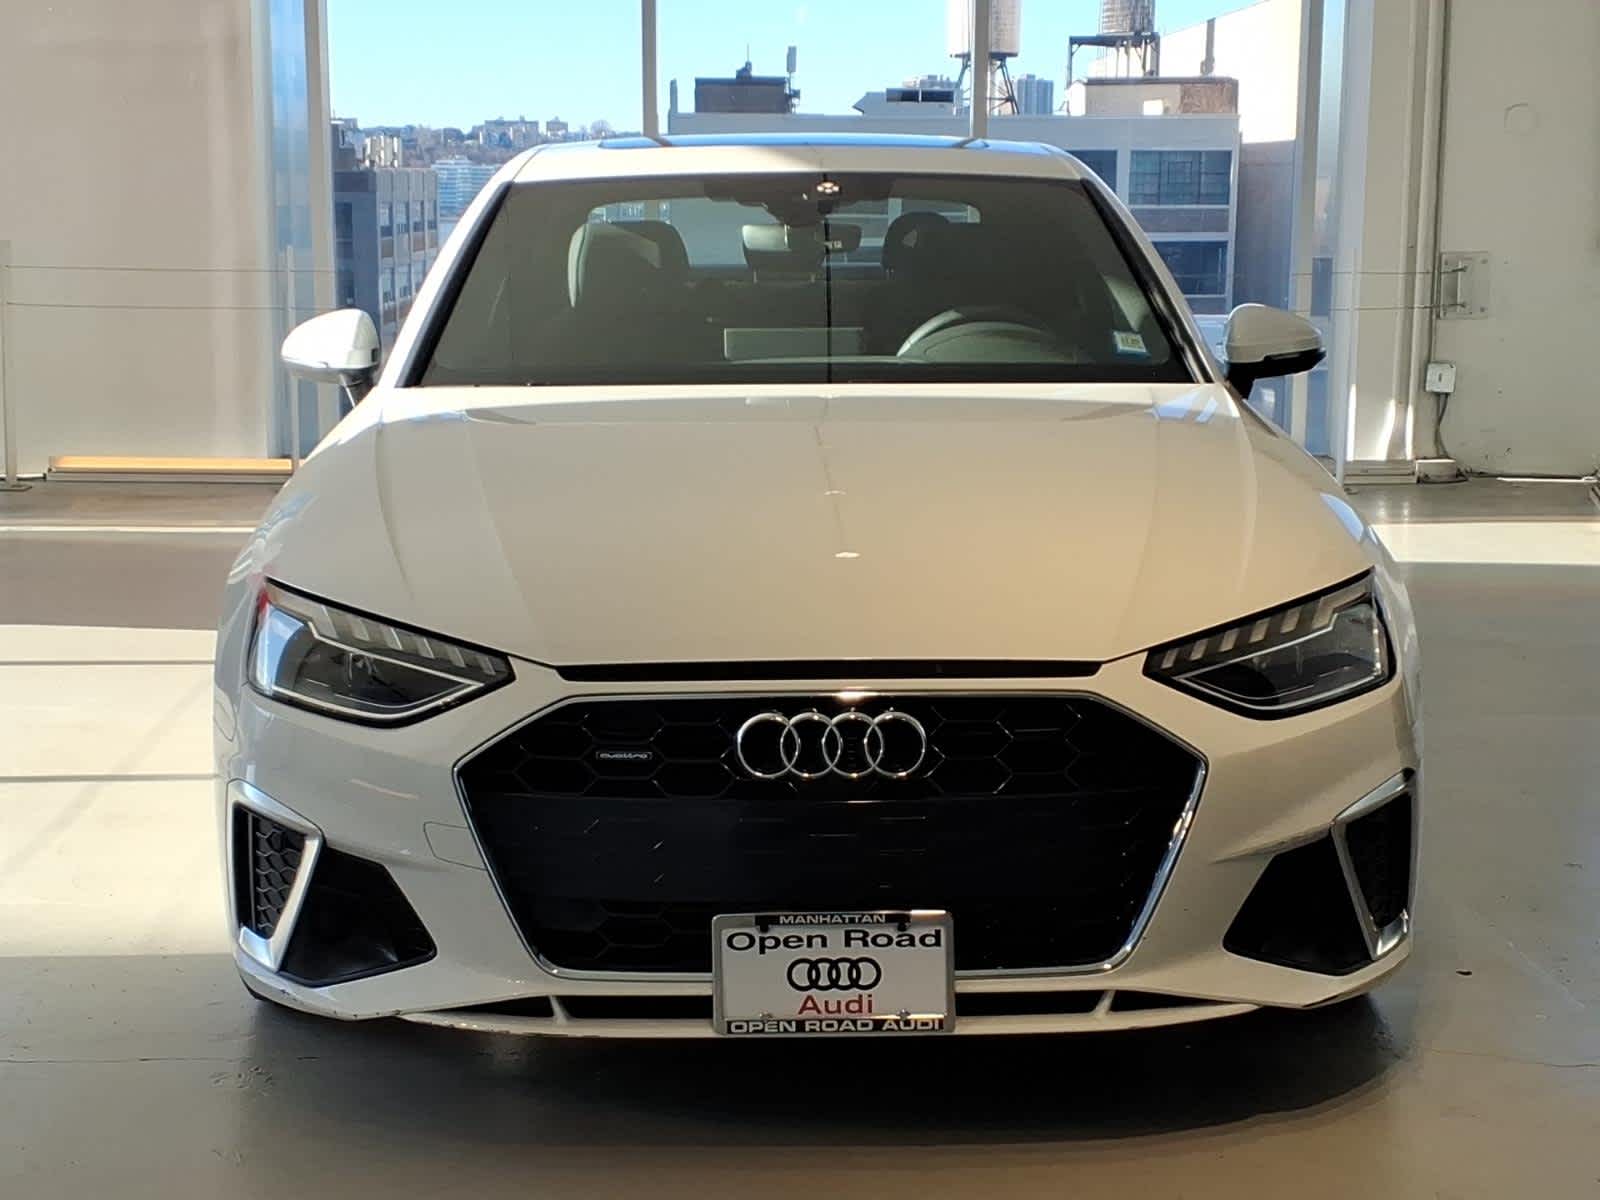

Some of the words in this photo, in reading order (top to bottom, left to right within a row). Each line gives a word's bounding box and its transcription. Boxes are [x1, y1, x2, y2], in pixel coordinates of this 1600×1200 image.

[779, 914, 886, 925] MANHATTAN
[726, 931, 828, 955] Open
[843, 929, 942, 948] Road
[798, 994, 873, 1015] Audi
[730, 1020, 797, 1033] OPEN
[804, 1020, 874, 1032] ROAD
[881, 1018, 940, 1031] AUDI
